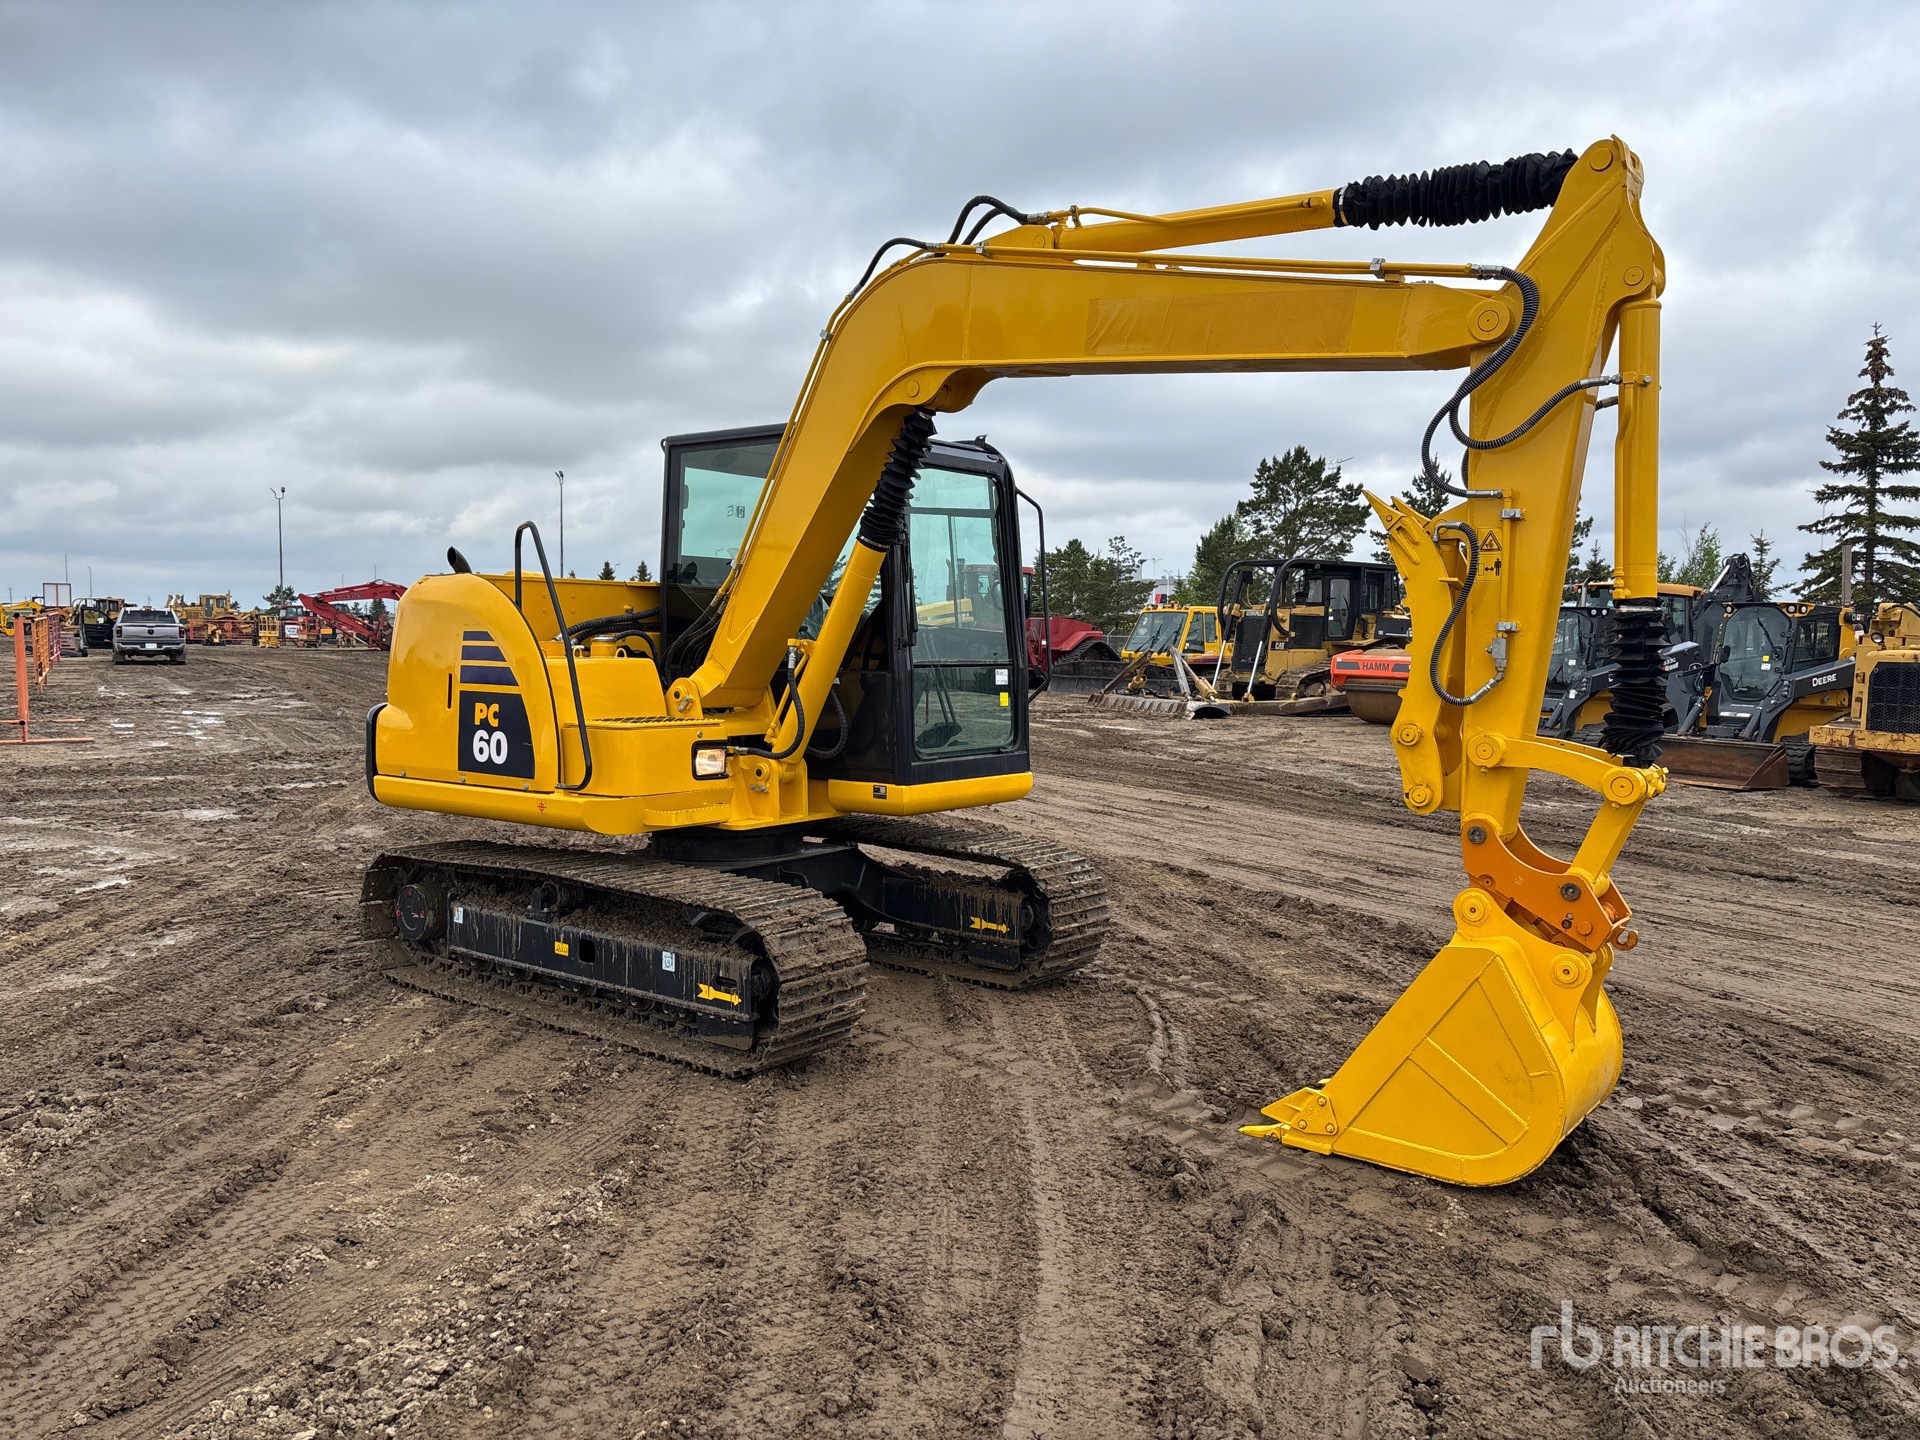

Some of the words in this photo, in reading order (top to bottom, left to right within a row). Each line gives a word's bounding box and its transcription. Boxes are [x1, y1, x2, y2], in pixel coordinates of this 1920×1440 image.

[1275, 642, 1285, 650] CAT
[1362, 662, 1390, 672] HAMM
[1812, 673, 1837, 688] DEERE
[474, 702, 500, 727] PC
[472, 729, 508, 765] 60
